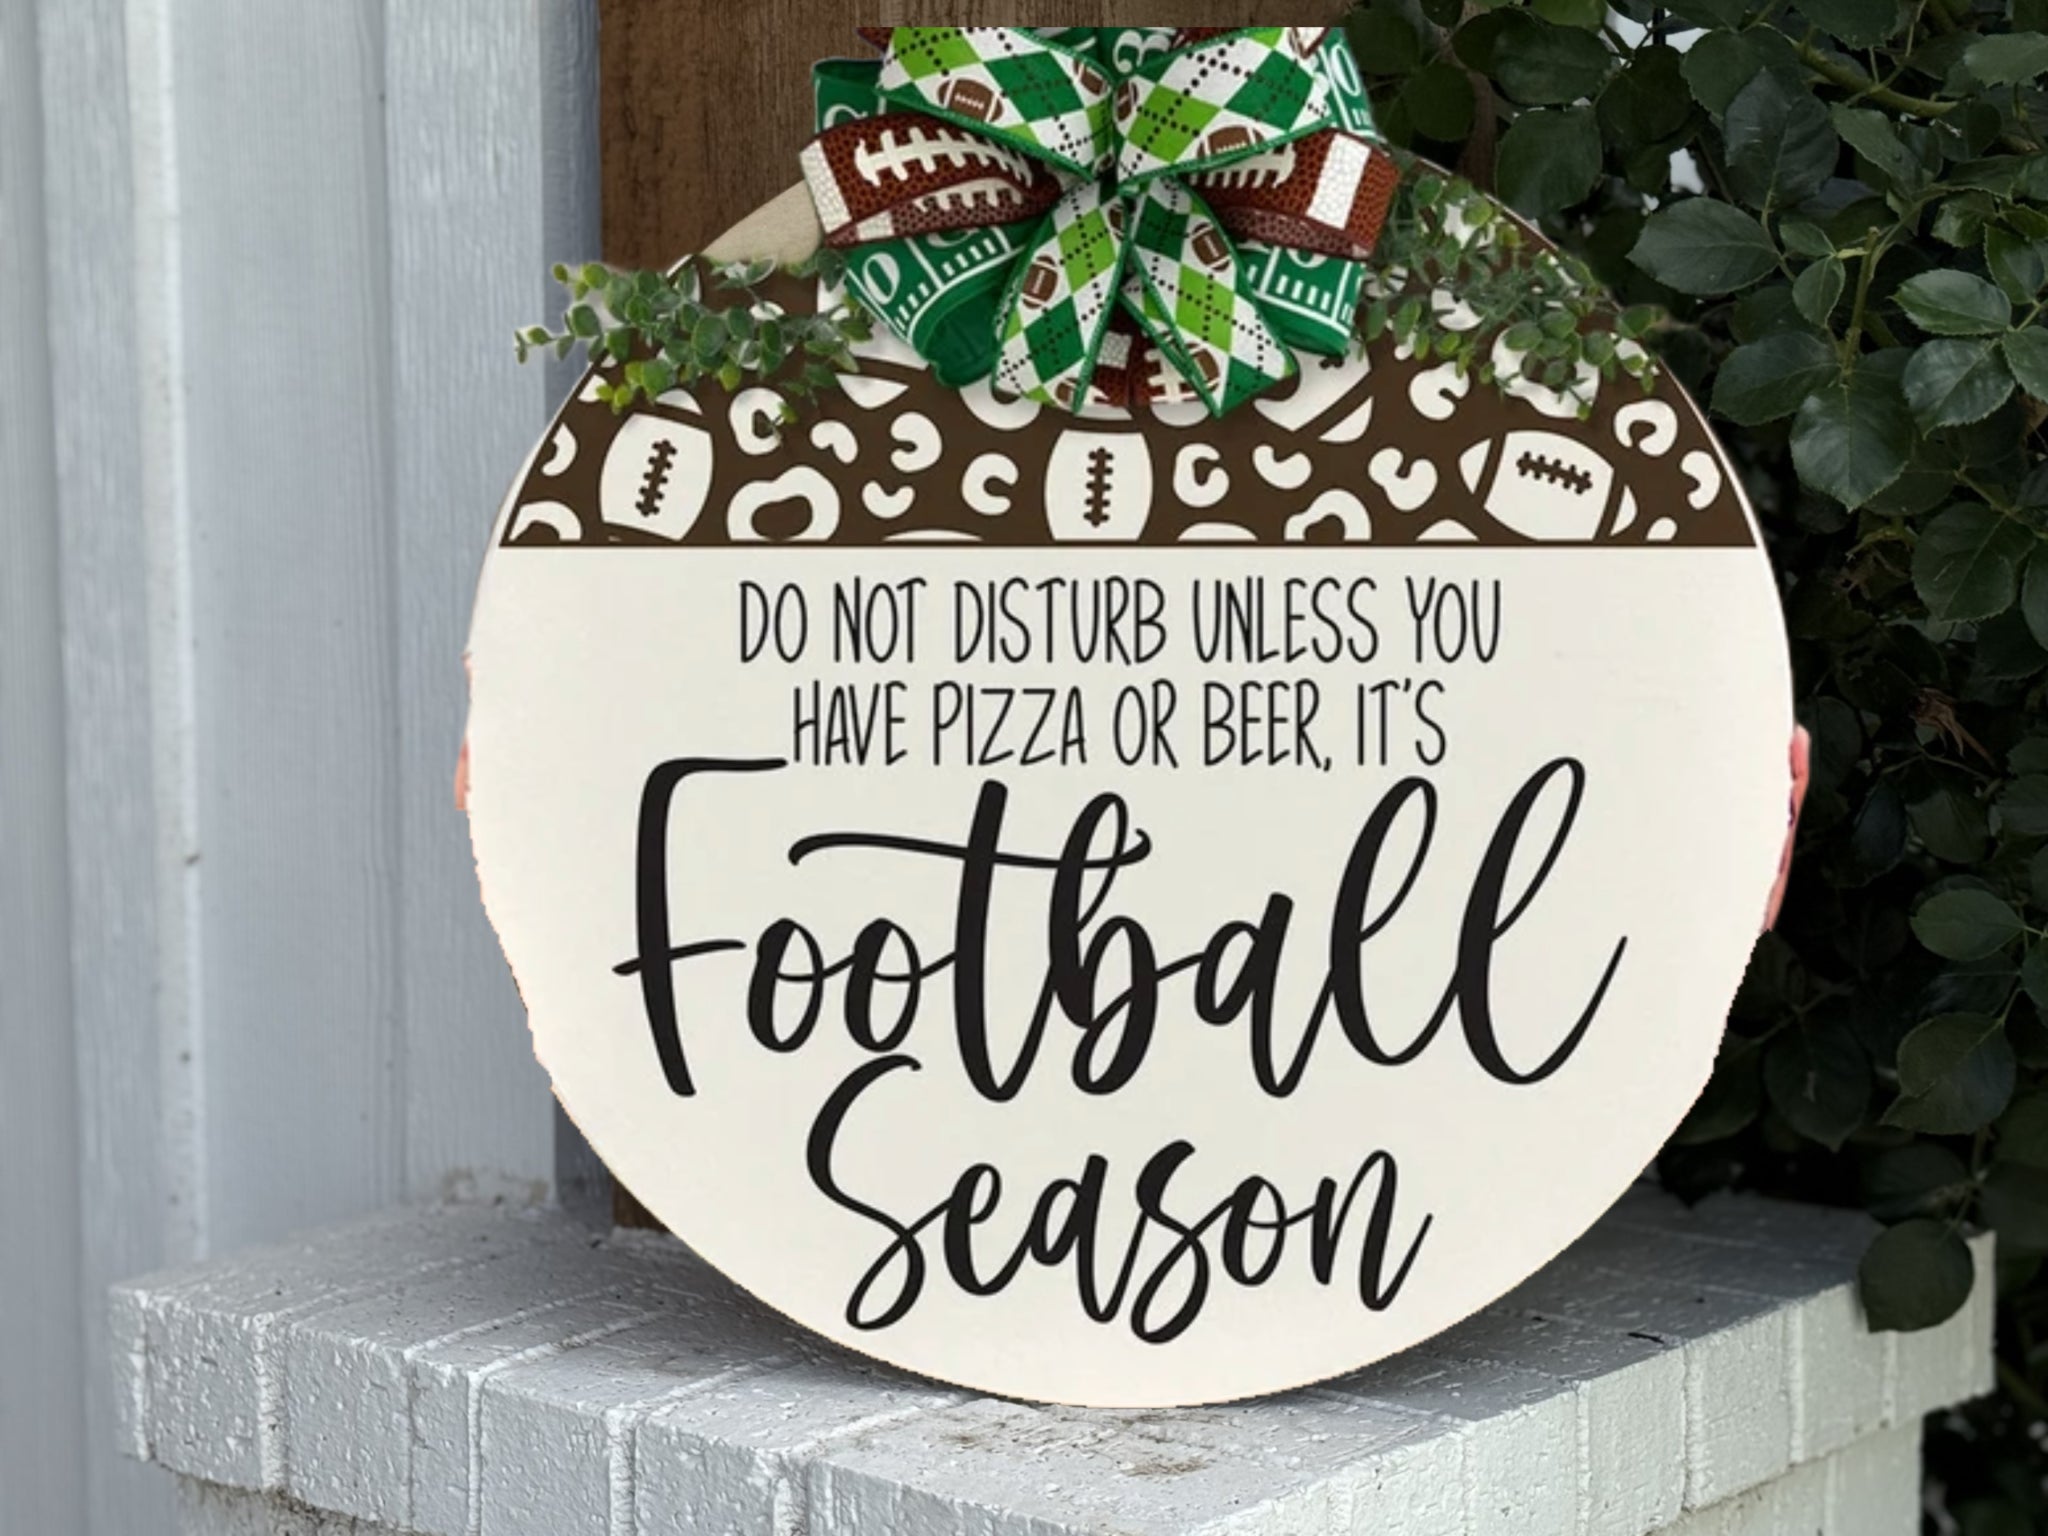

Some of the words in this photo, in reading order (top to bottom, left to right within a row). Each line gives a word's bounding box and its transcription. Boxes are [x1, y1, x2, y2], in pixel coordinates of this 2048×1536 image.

[740, 581, 807, 663] DO
[835, 577, 926, 662] NOT
[955, 576, 1166, 665] DISTURB
[1194, 577, 1377, 663] UNLESS
[1406, 577, 1500, 663] YOU
[794, 680, 906, 765] HAVE
[934, 681, 1086, 765] PIZZA
[1114, 679, 1177, 768] OR
[1204, 679, 1331, 771] BEER,
[1358, 678, 1445, 765] IT'S
[613, 758, 1627, 1102] Football
[807, 1055, 1432, 1344] Season
